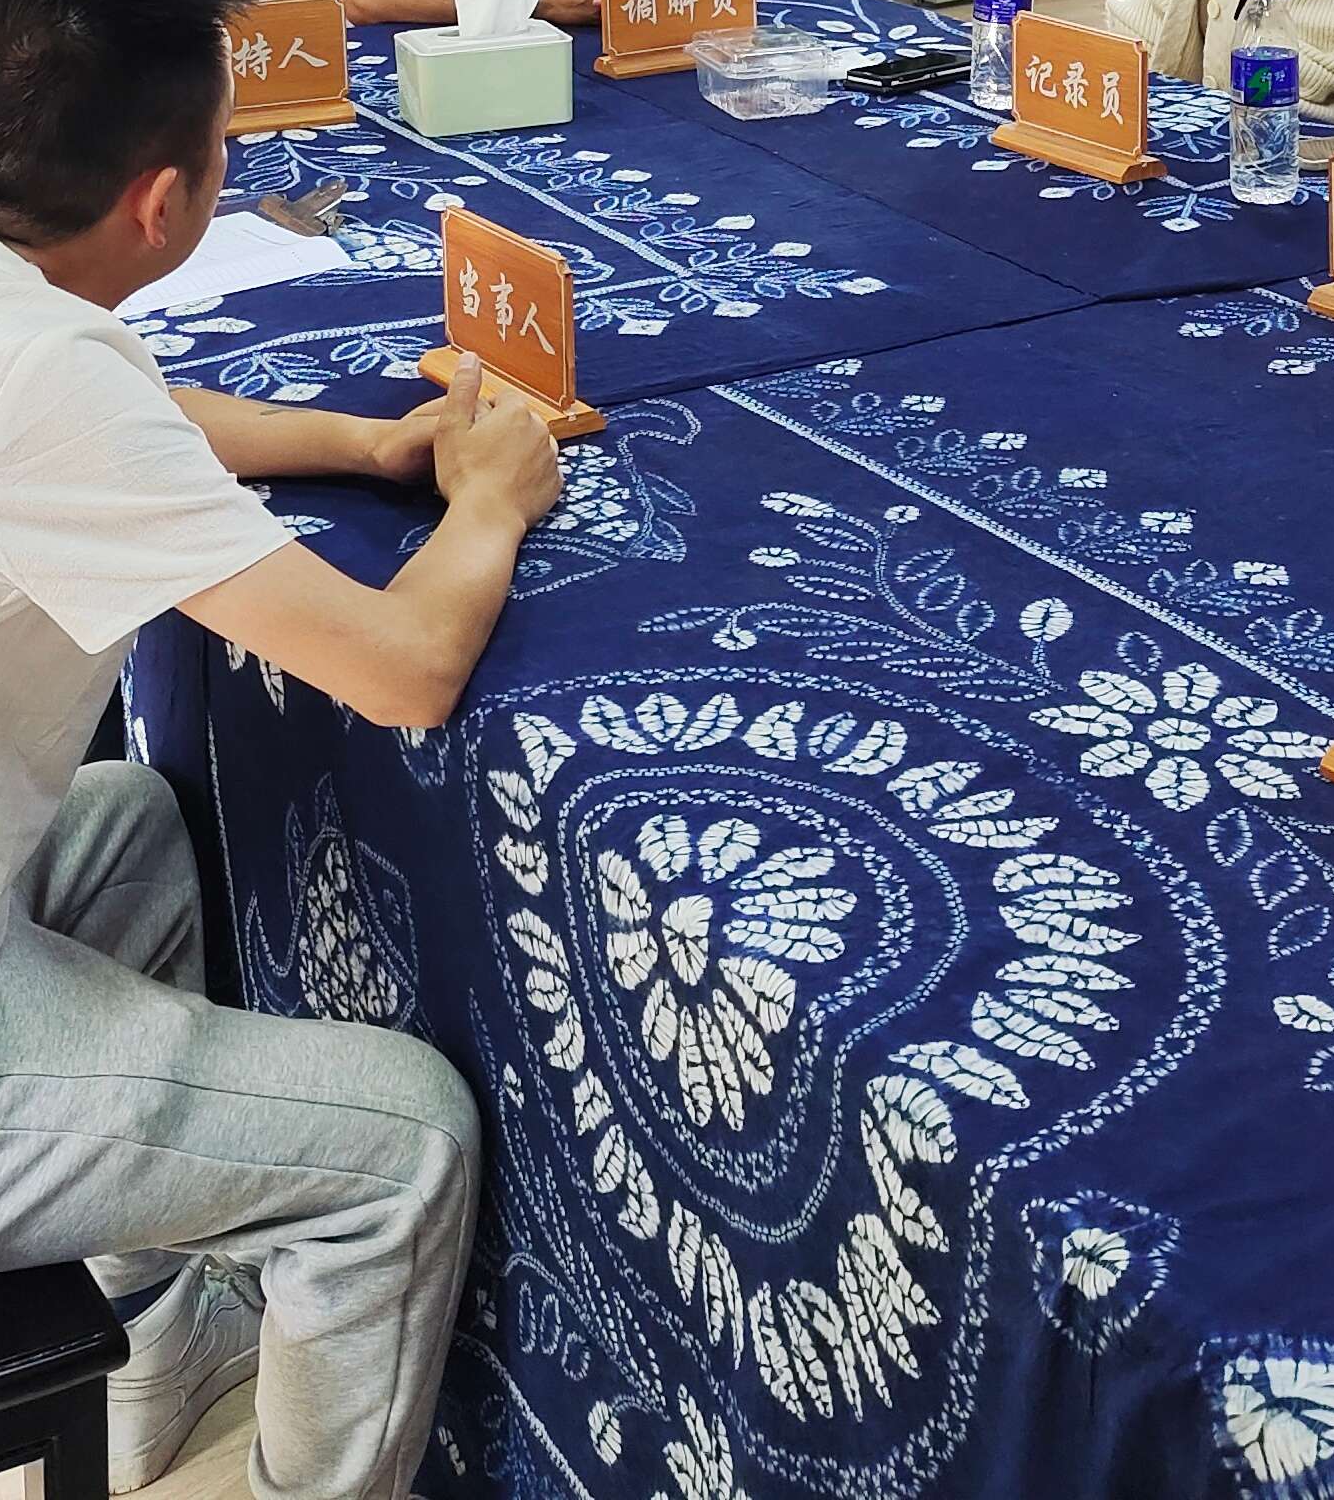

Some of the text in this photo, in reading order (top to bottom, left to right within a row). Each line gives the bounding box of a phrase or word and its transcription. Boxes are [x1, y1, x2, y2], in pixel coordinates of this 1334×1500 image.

[233, 32, 330, 82] 持人
[1025, 53, 1125, 125] 记录员
[459, 256, 556, 356] 当事人
